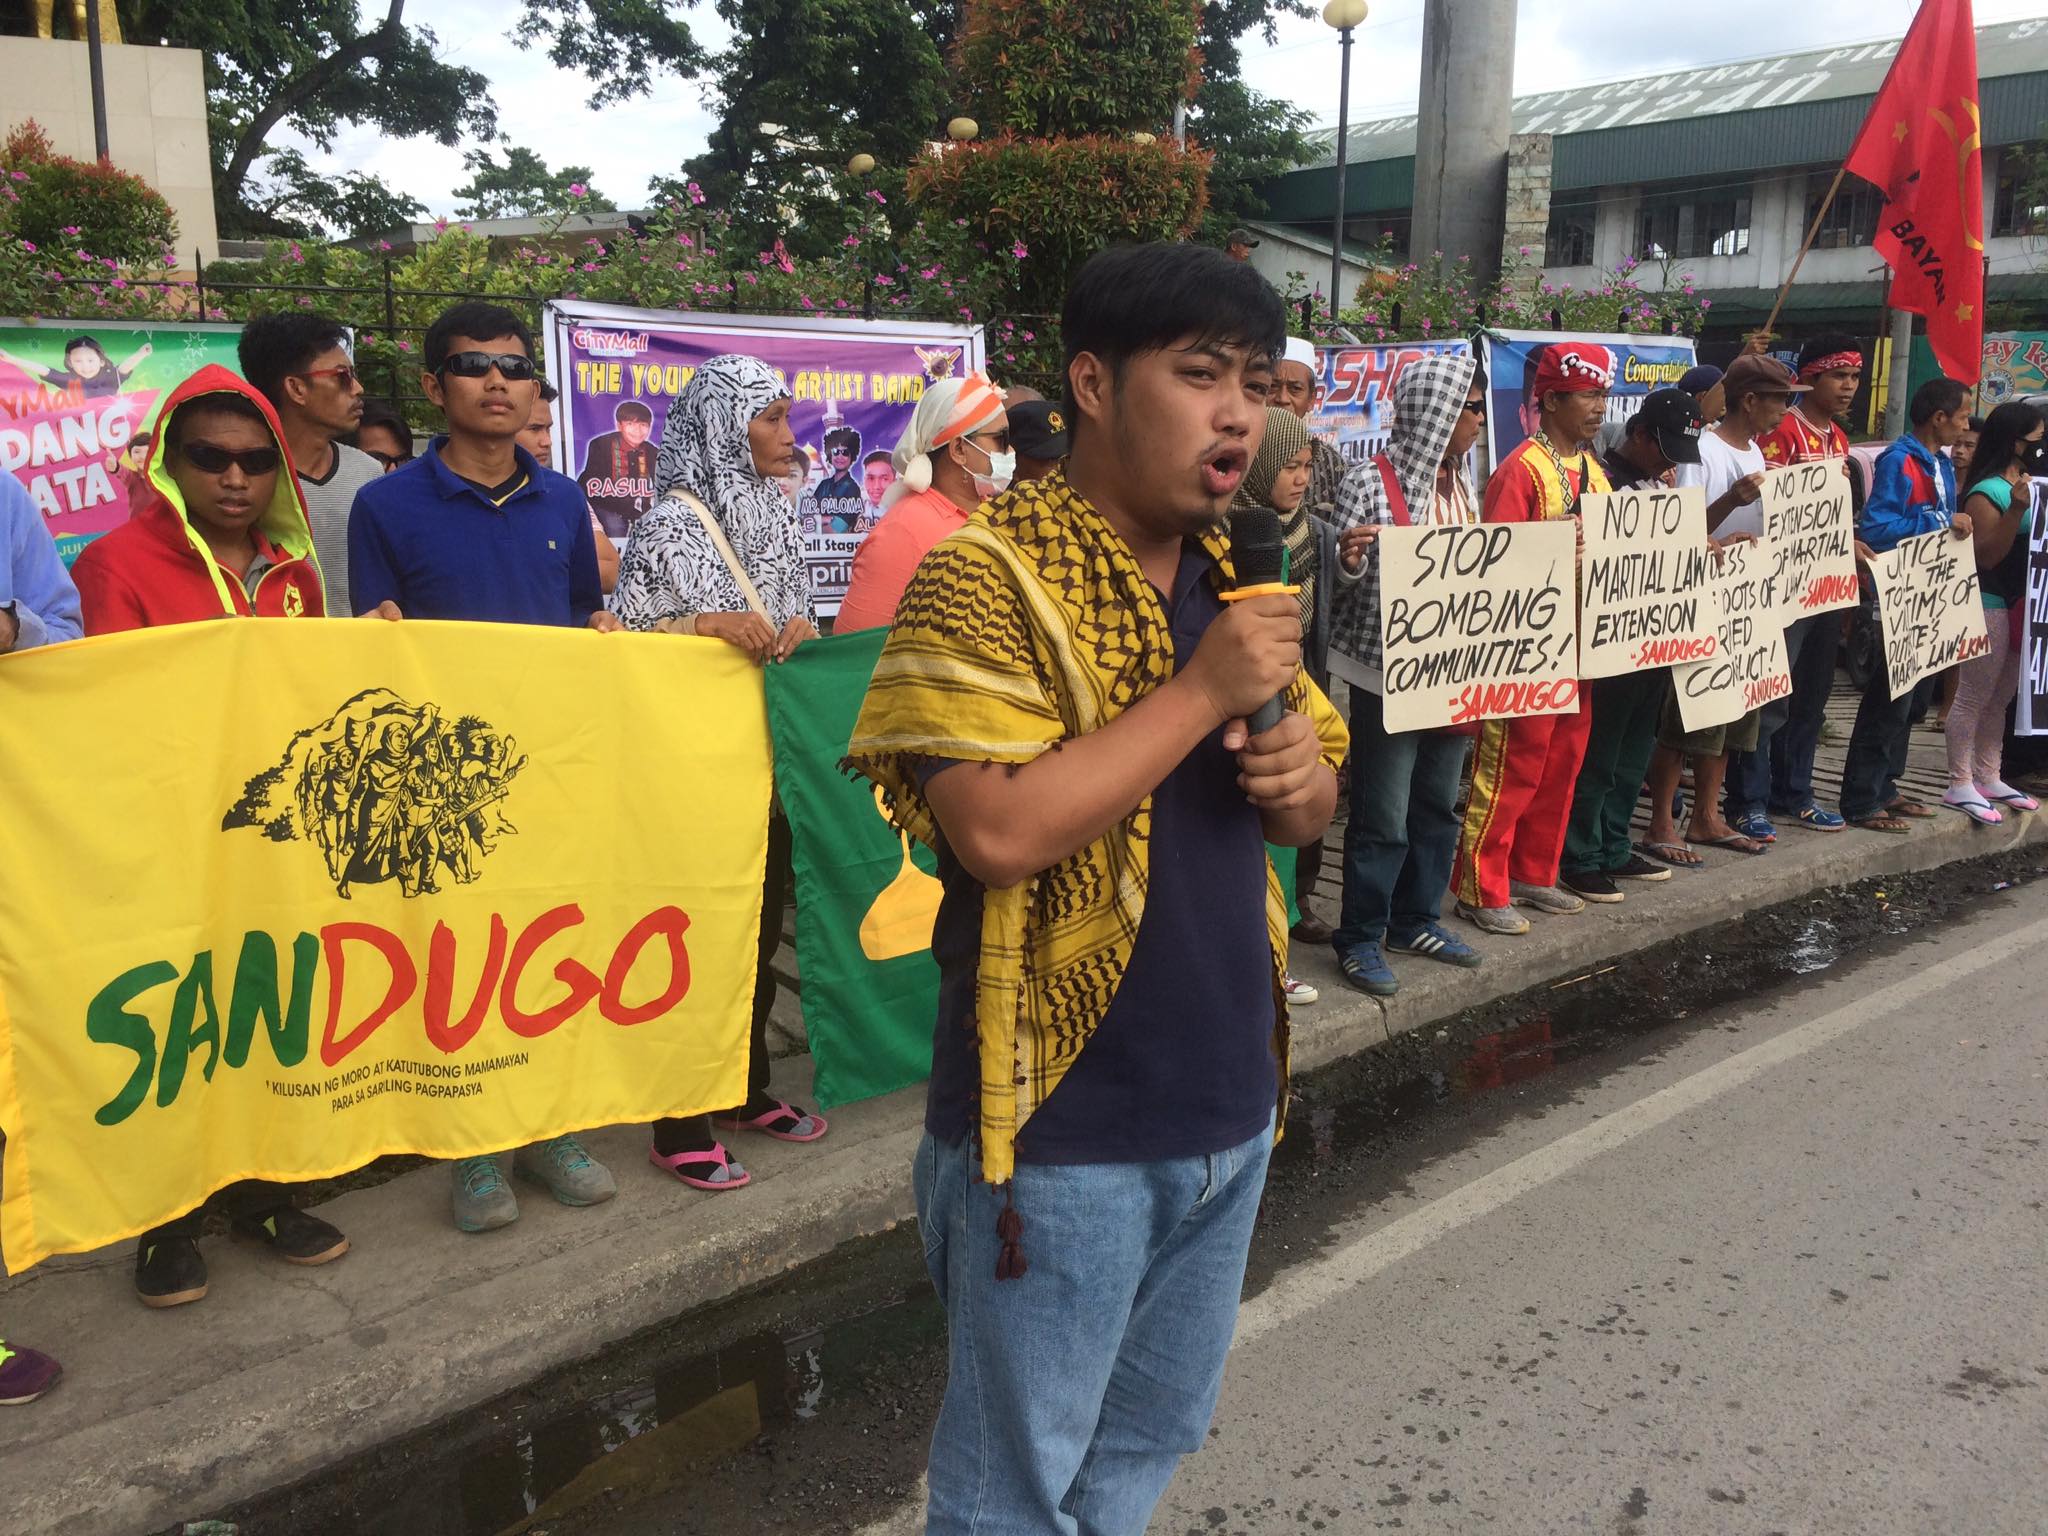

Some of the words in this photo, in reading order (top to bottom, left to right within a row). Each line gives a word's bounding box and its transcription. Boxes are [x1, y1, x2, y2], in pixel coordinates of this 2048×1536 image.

[1817, 41, 1899, 67] PIL
[576, 361, 622, 396] THE
[631, 363, 697, 398] YOUN
[794, 370, 865, 403] ARTIST
[871, 373, 925, 406] BAND
[29, 462, 117, 517] ATA
[1773, 471, 1795, 501] NO
[1801, 466, 1827, 493] TO
[1602, 495, 1640, 540] NO
[1649, 494, 1682, 539] TO
[1768, 495, 1844, 543] EXTENSION
[804, 539, 820, 552] all
[1412, 526, 1512, 587] STOP
[1585, 550, 1666, 608] MARTIAL
[1672, 546, 1708, 594] LAW
[1760, 576, 1777, 608] OF
[1926, 557, 1958, 587] THE
[1952, 572, 1977, 606] OF
[1385, 586, 1561, 649] BOMBING
[1591, 598, 1697, 649] EXTENSION
[1385, 632, 1574, 694] COMMUNITIES!
[86, 903, 691, 1126] SANDUGO
[324, 1079, 339, 1093] NG
[342, 1065, 370, 1086] MORO
[373, 1059, 385, 1076] AT
[386, 1058, 462, 1078] KATUTUBONG
[464, 1052, 529, 1077] MAMAMAYAN
[332, 1095, 354, 1113] PARA
[356, 1089, 366, 1104] SA
[415, 1081, 483, 1099] PAGPAPASYA
